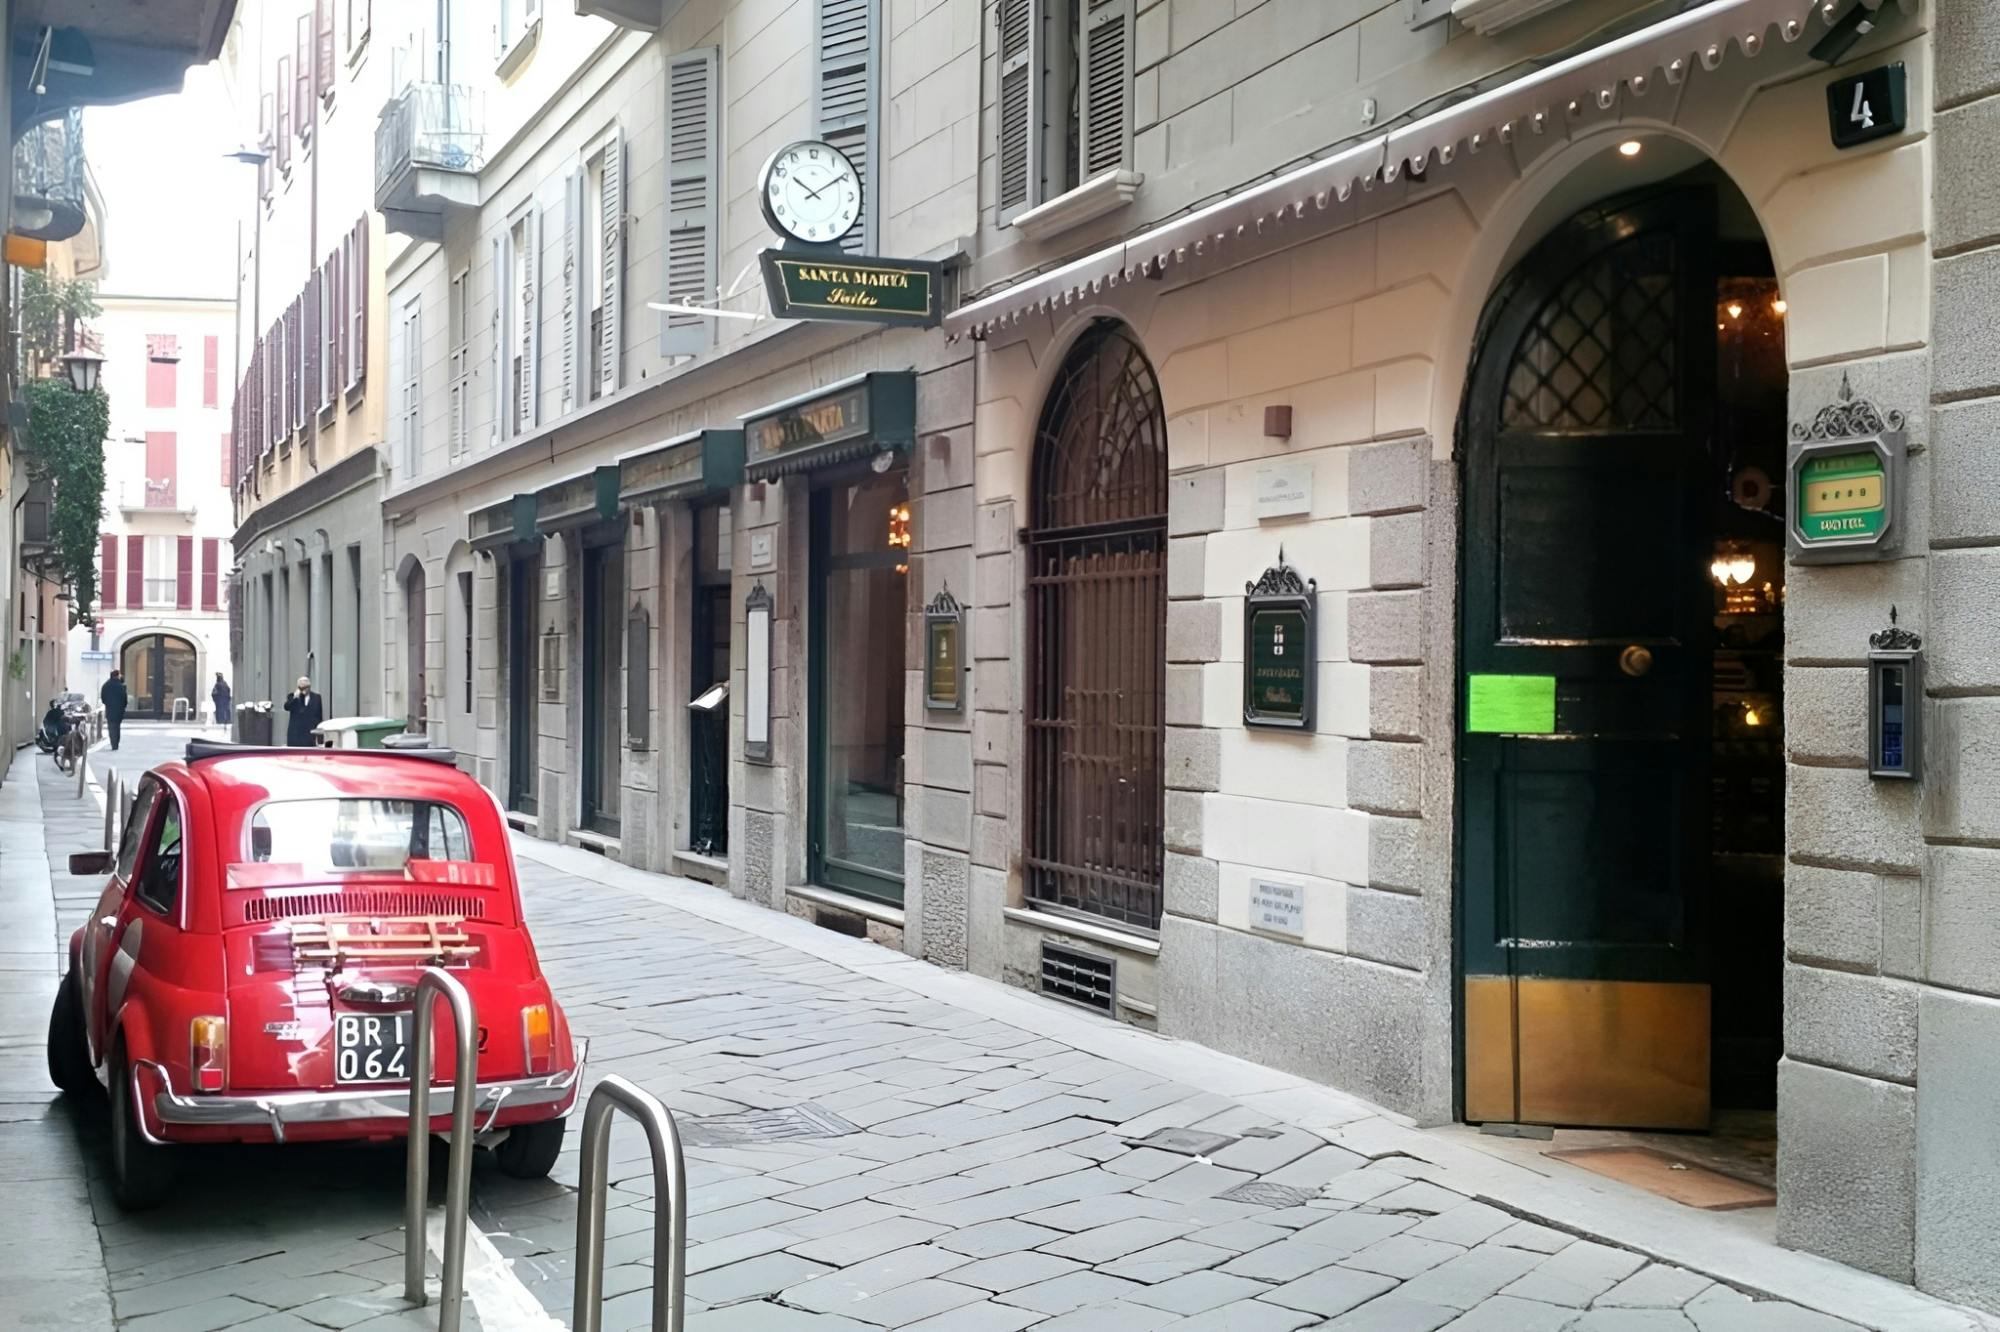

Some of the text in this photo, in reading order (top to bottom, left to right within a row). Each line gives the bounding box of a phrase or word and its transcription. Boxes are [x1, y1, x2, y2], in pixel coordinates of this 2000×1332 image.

[1850, 82, 1874, 128] 4
[799, 268, 849, 284] SANTA
[341, 1017, 382, 1047] BR
